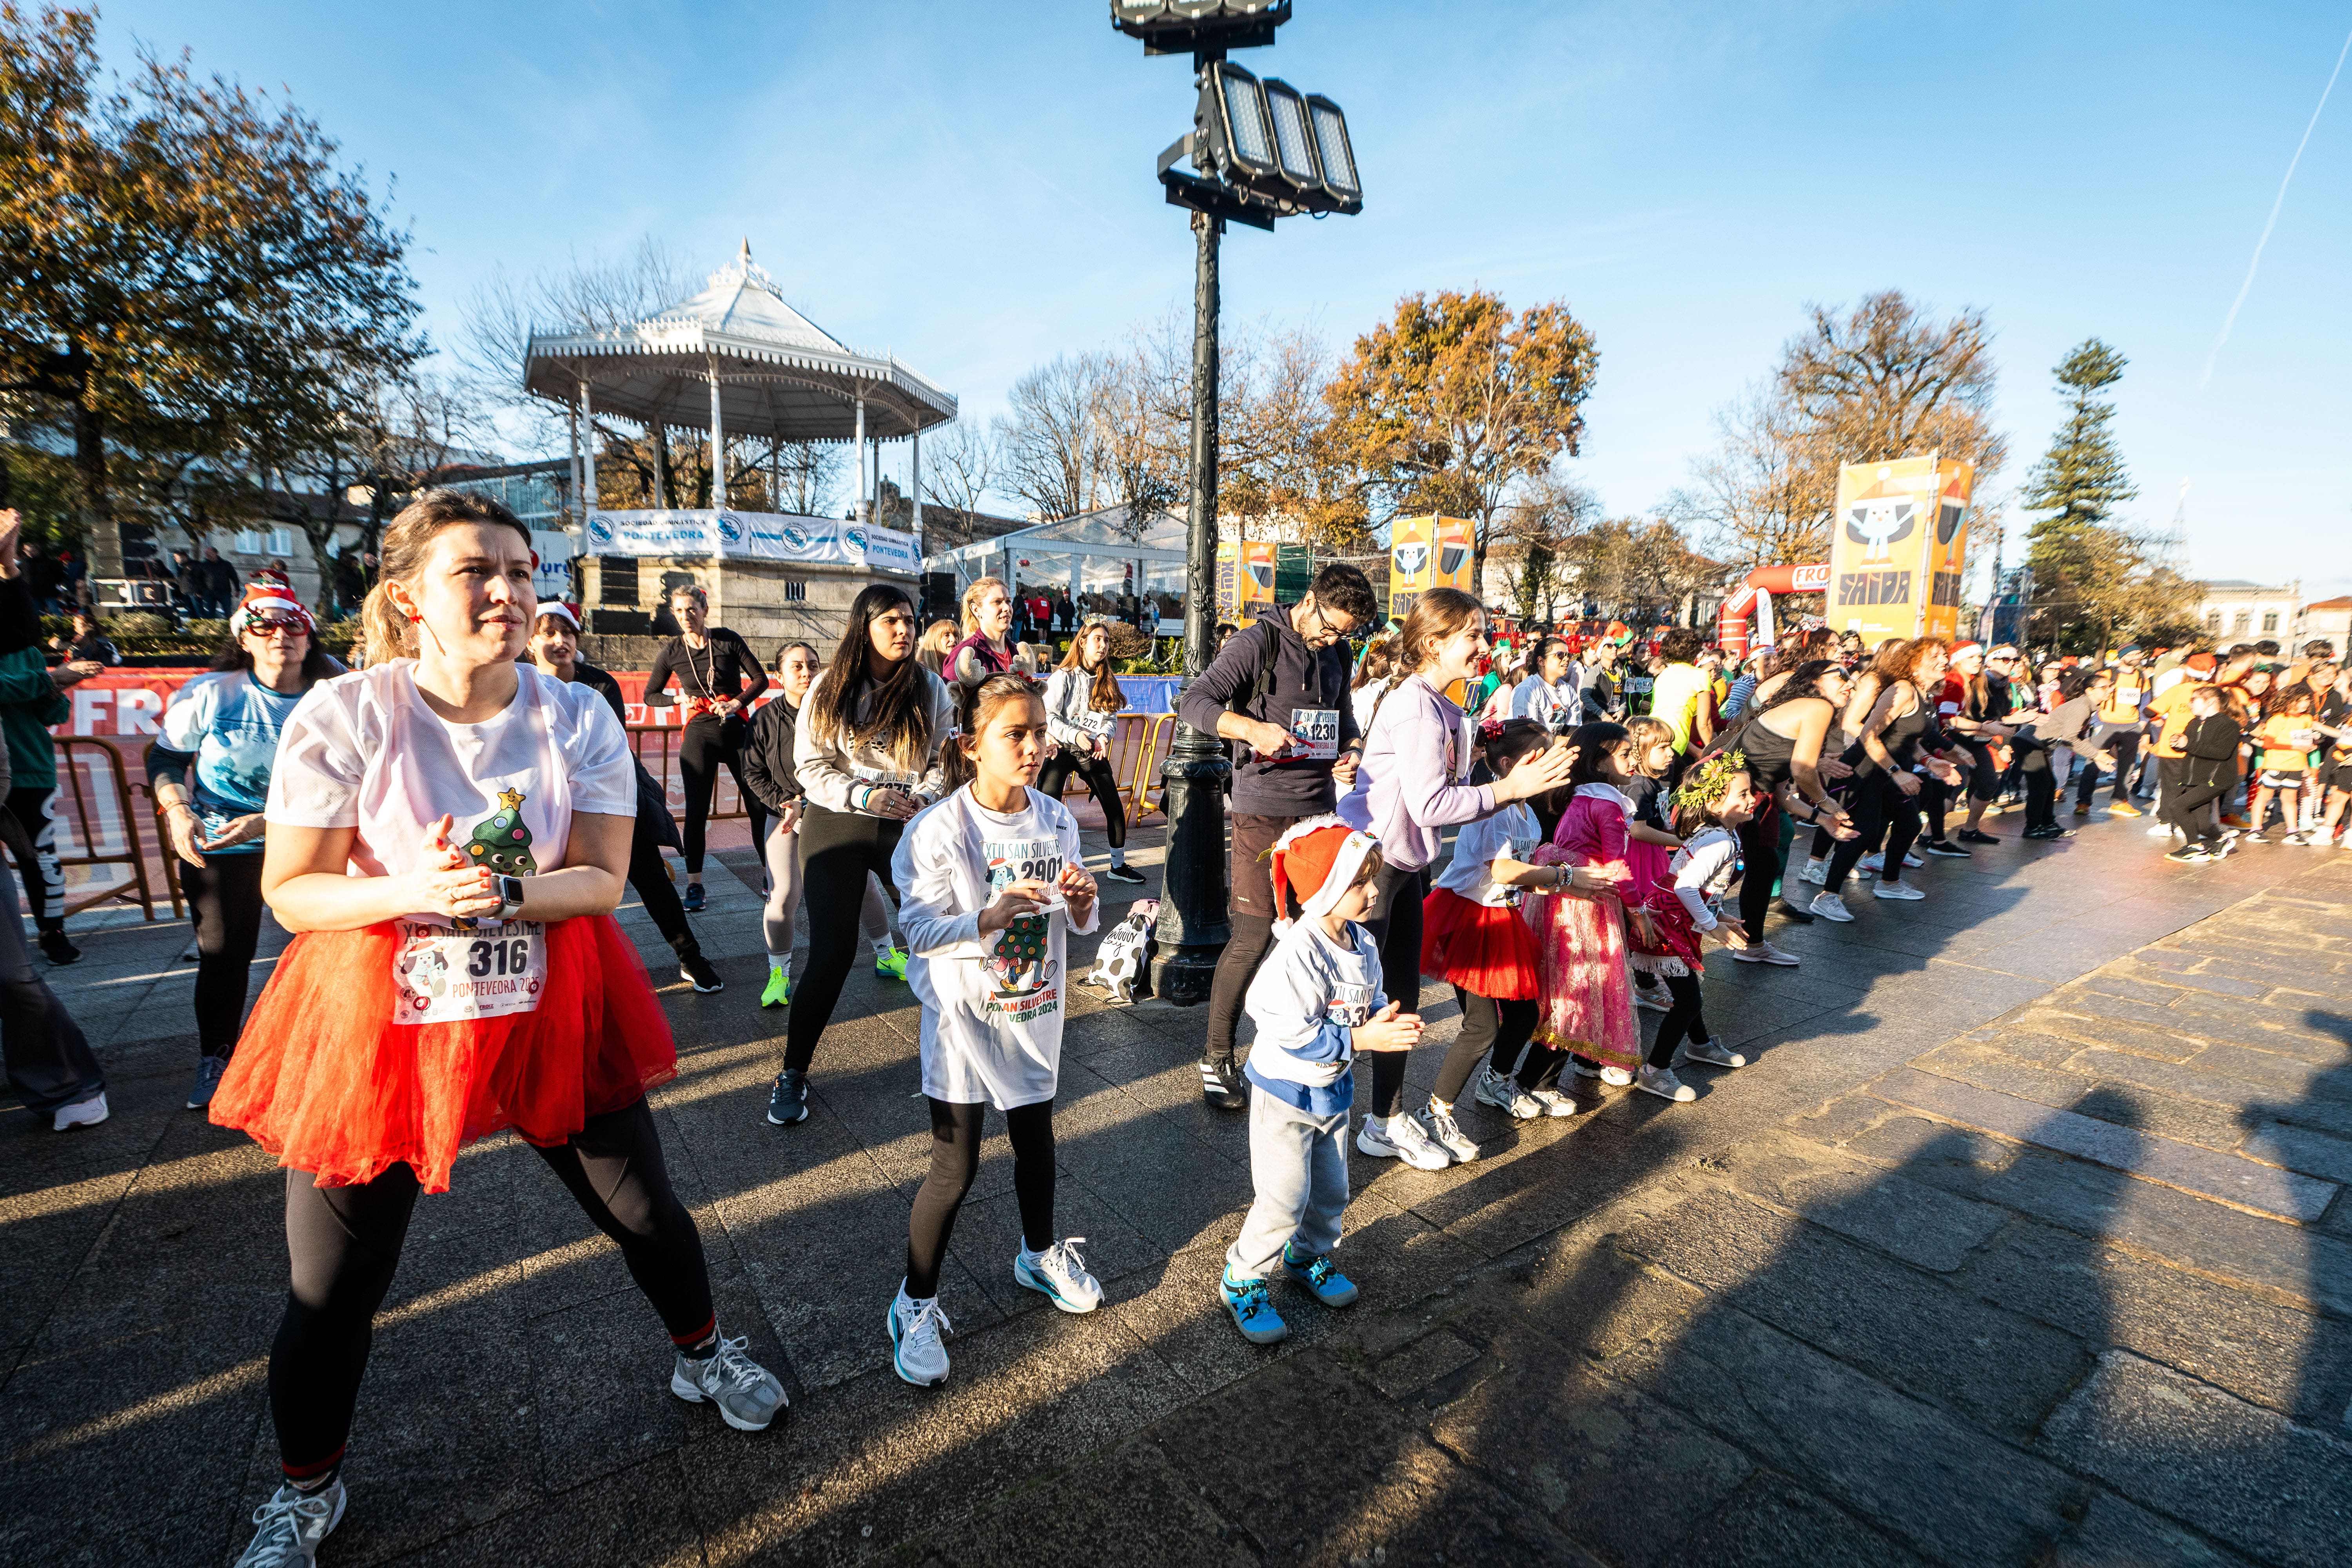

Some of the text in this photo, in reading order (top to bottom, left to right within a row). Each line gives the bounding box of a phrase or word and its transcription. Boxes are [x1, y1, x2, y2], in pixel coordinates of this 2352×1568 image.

[623, 530, 704, 540] PONTEVEDRA
[871, 534, 888, 542] SOCIEDAD
[873, 544, 908, 559] PONTEVEDRA
[73, 688, 180, 737] FR
[1311, 724, 1336, 740] 1230
[871, 771, 885, 782] SAN
[985, 843, 1004, 859] XLII
[1008, 843, 1028, 858] SAN
[1519, 840, 1530, 851] SAN
[1021, 855, 1063, 884] 2901
[469, 939, 528, 977] 316
[452, 981, 517, 998] PONTEVEDRA
[1347, 989, 1366, 1004] SAN
[1020, 988, 1057, 1011] SILVESTRE
[1038, 1000, 1058, 1016] 2024
